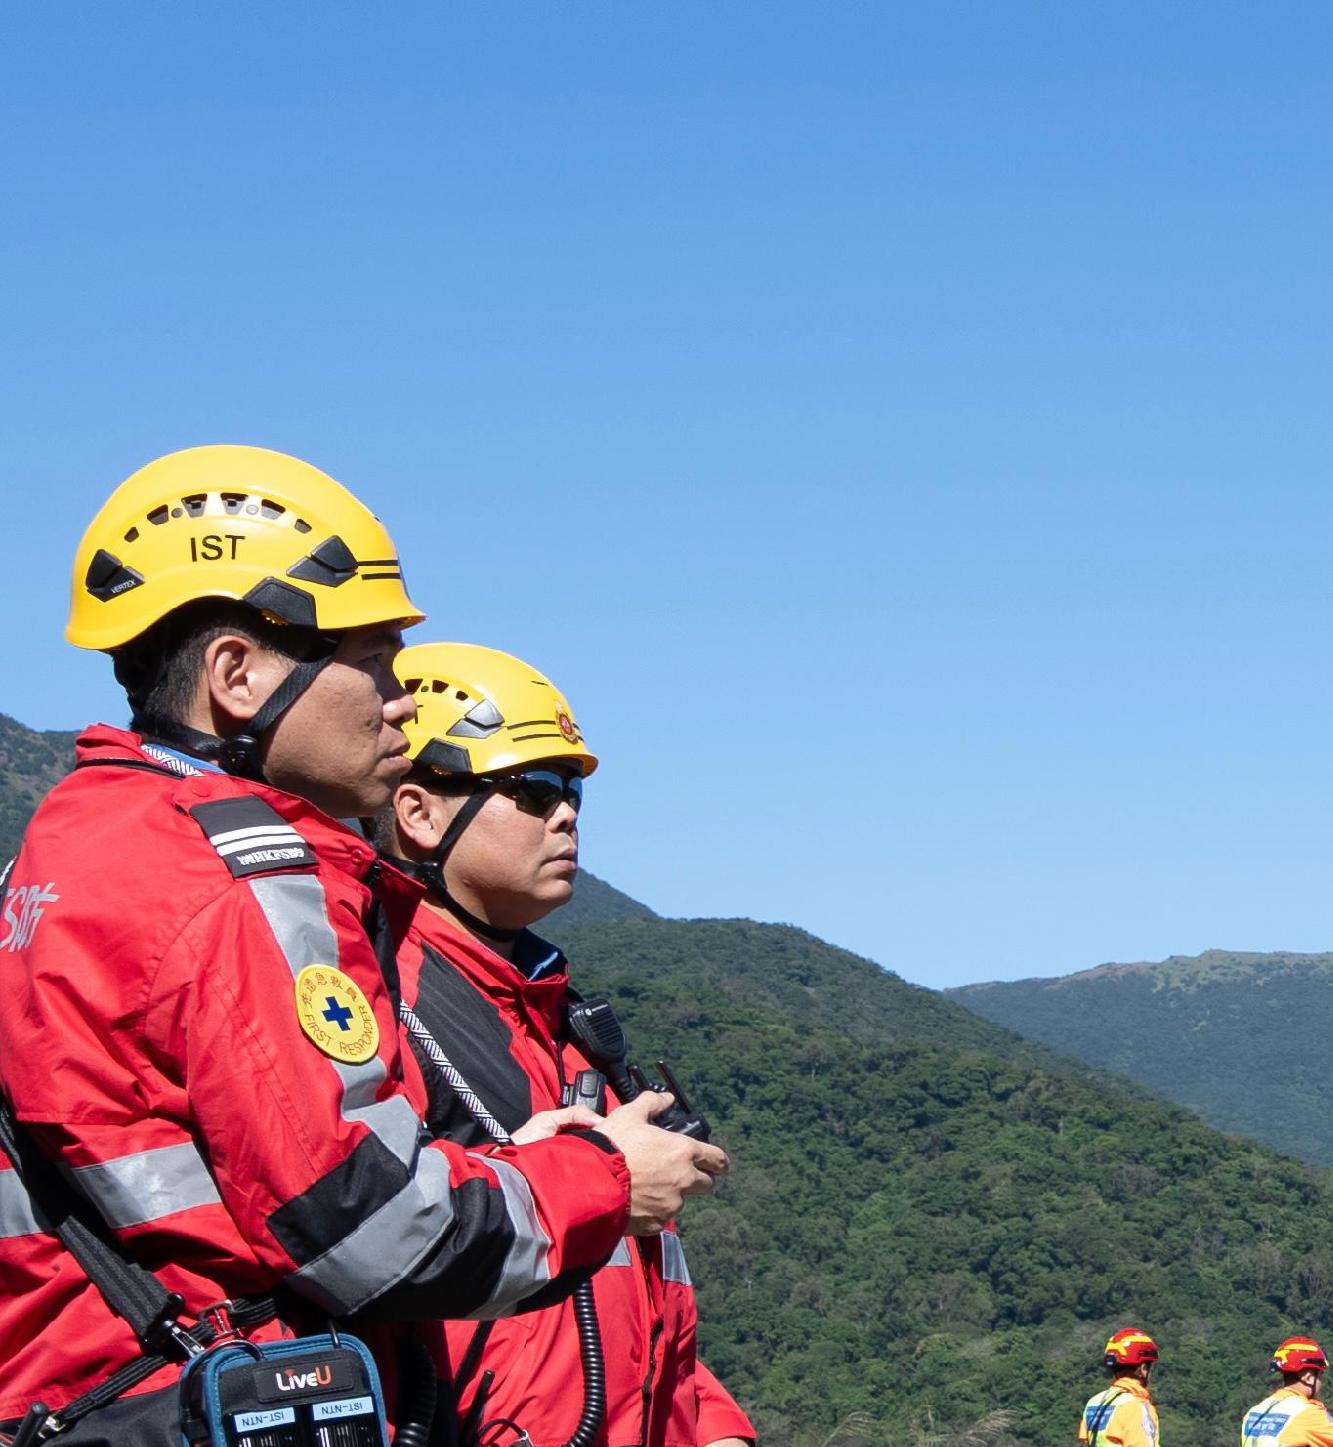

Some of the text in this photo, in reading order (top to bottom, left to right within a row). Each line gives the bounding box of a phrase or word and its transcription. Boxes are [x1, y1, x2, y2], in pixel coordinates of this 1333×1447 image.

[190, 534, 246, 562] IST
[304, 1004, 374, 1056] FIRST RESPONDER
[242, 1411, 285, 1427] IST-NTN
[321, 1402, 364, 1415] IST-NTN
